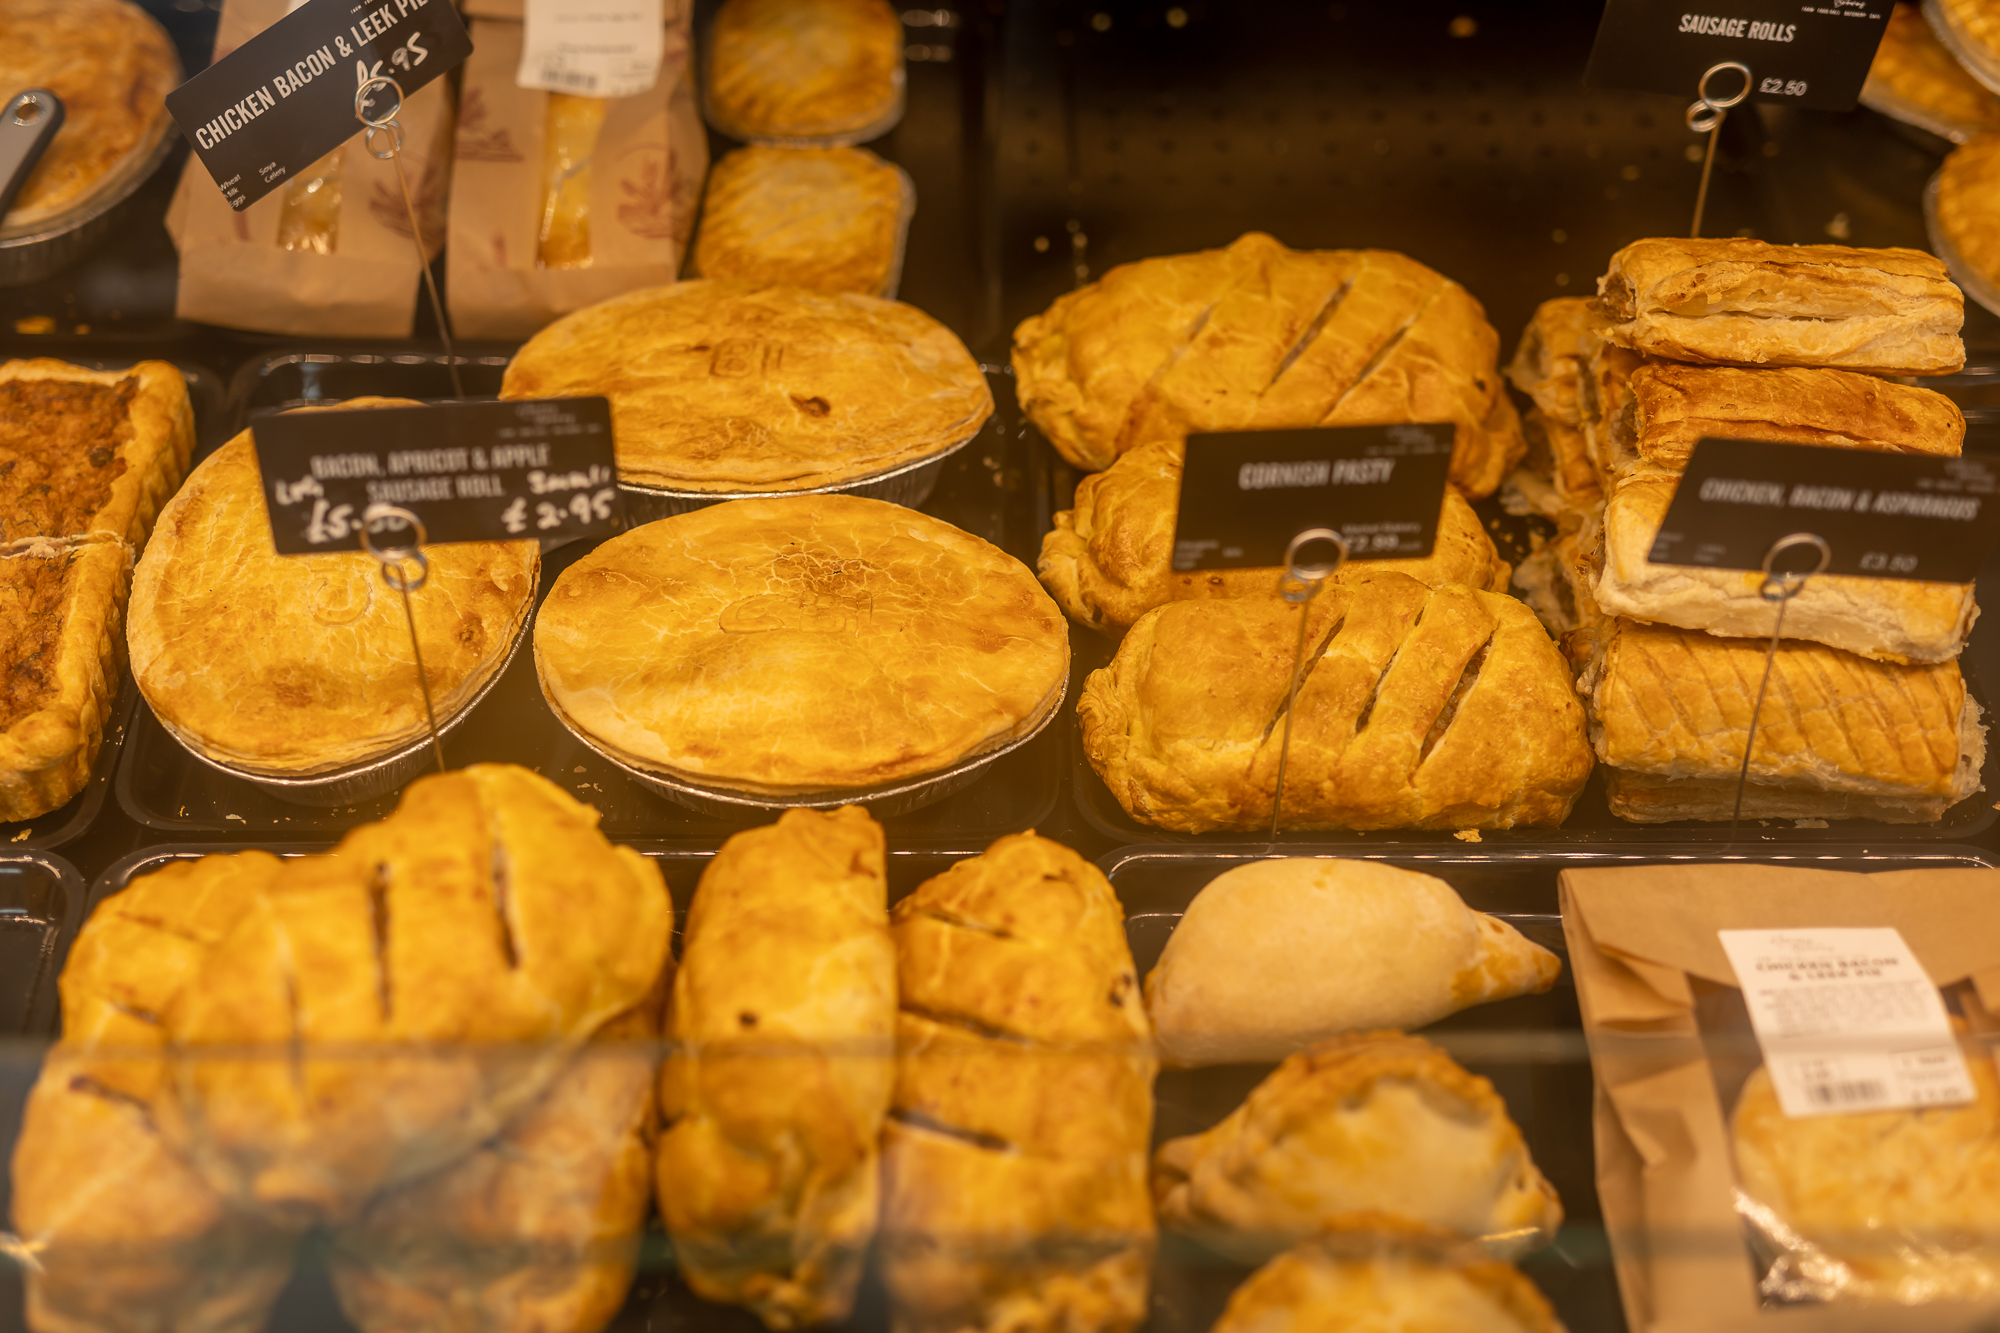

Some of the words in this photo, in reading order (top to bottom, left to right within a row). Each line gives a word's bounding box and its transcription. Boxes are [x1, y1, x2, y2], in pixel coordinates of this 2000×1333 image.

[1678, 13, 1748, 38] SAUSAGE
[1747, 20, 1797, 43] ROLLS
[195, 85, 276, 150] CHICKEN
[272, 46, 337, 99] BACON
[334, 36, 354, 58] &
[350, 3, 399, 47] LEEK
[1758, 77, 1808, 97] £2.50
[258, 161, 277, 176] Soya
[264, 166, 286, 183] Celery
[309, 452, 386, 479] BACON,
[387, 447, 469, 475] APRICOT
[471, 446, 489, 471] &
[490, 442, 550, 469] APPLE
[1238, 459, 1331, 491] CORNISH
[1331, 457, 1396, 486] PASTY
[366, 476, 453, 502] SAUSAGE
[455, 473, 506, 499] ROLL
[1699, 477, 1786, 507] CHICKEN,
[1789, 483, 1855, 511] BACON
[1853, 489, 1873, 513] &
[1872, 490, 1981, 521] ASPARAGUS
[500, 486, 616, 534] £2.95
